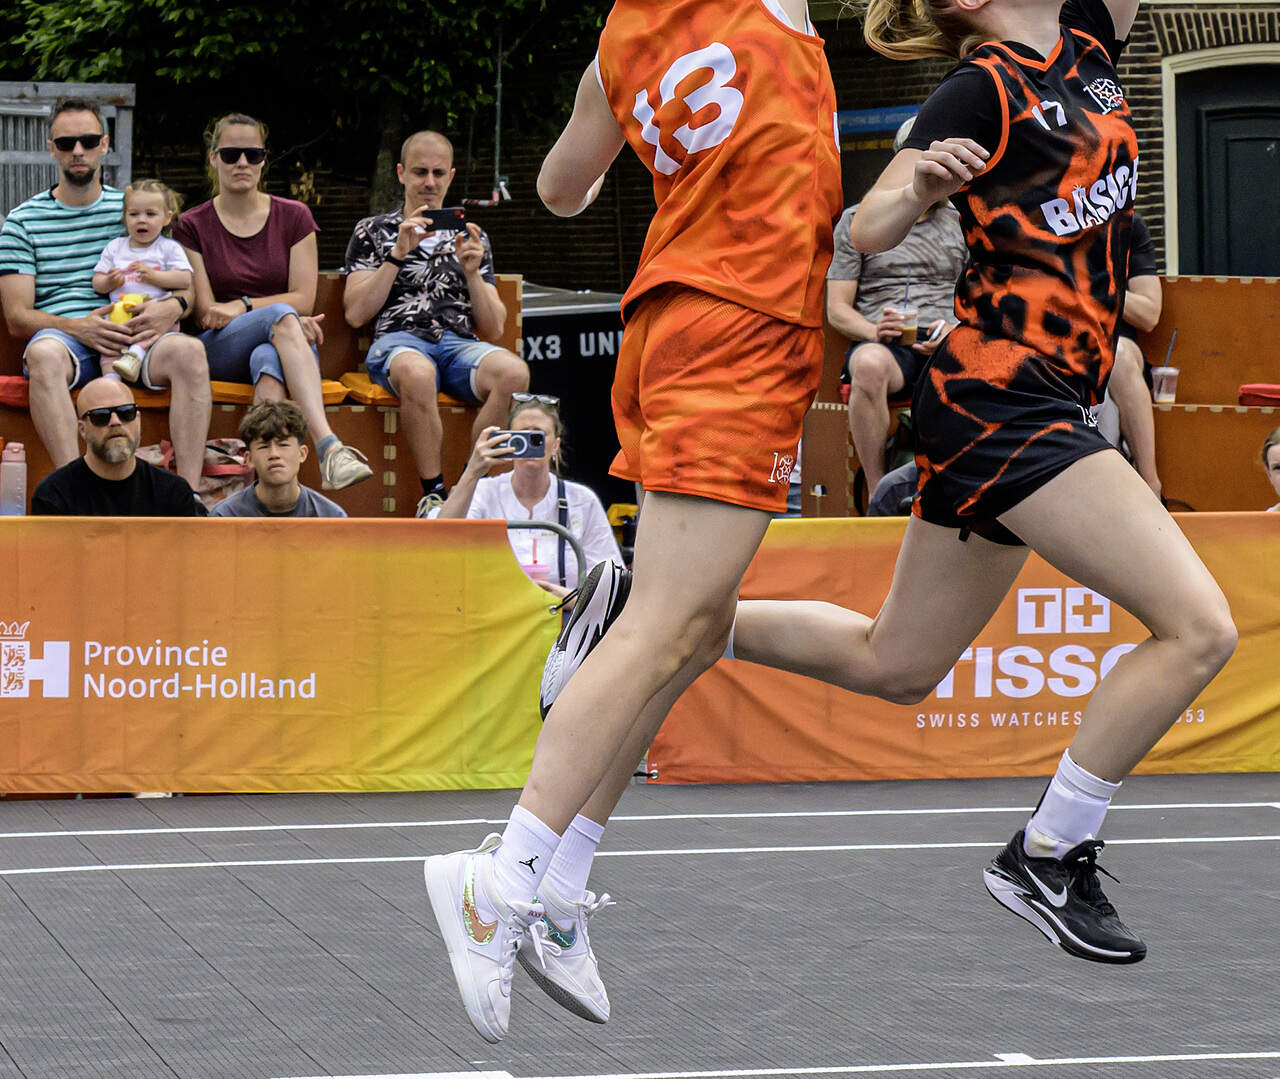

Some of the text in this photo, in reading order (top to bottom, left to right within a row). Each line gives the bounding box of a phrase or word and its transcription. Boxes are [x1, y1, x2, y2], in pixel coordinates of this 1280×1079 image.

[632, 42, 744, 176] 13
[1031, 99, 1068, 131] 17
[522, 334, 561, 361] X3
[84, 639, 228, 667] Provincie
[83, 672, 317, 699] Noord-Holland
[916, 712, 980, 728] SWISS
[991, 710, 1082, 726] WATCHES
